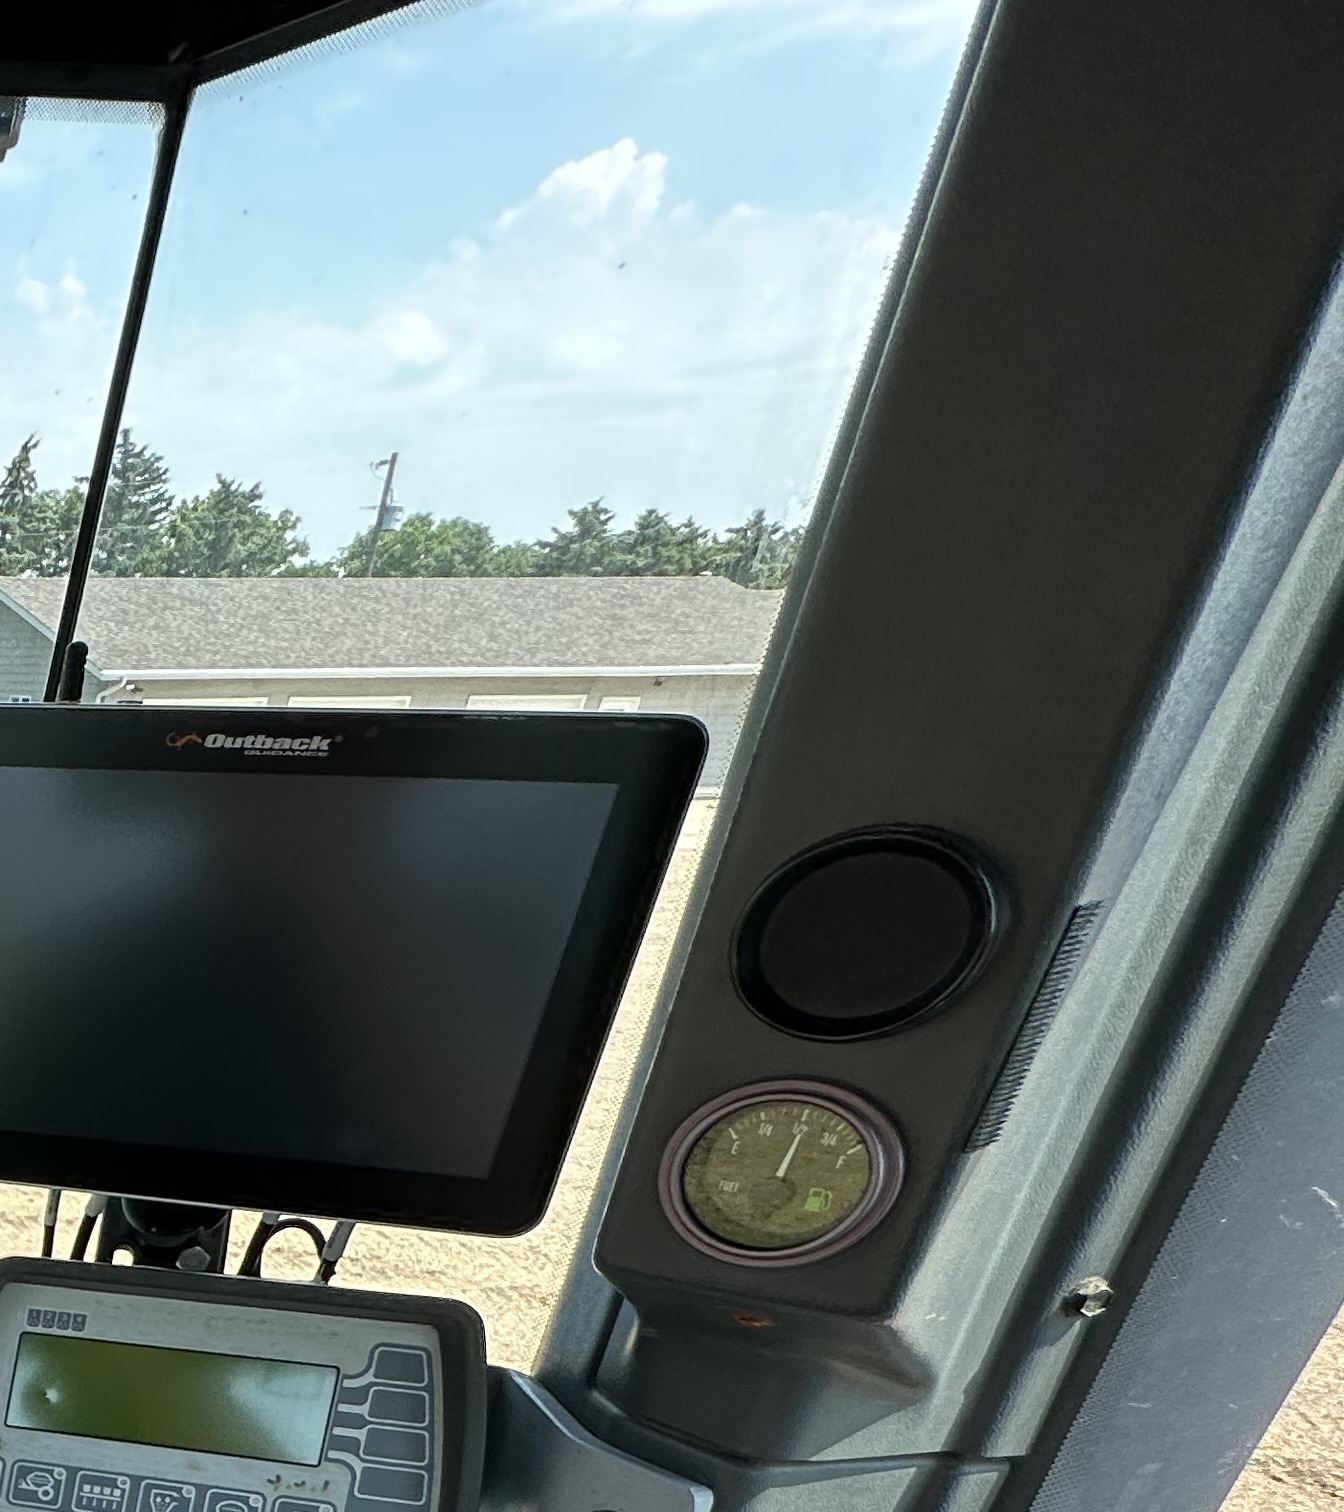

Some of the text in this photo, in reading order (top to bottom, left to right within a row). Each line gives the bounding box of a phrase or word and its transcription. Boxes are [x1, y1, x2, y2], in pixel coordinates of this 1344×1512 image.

[204, 733, 333, 750] Outback
[730, 1141, 741, 1155] E
[835, 1155, 847, 1169] F
